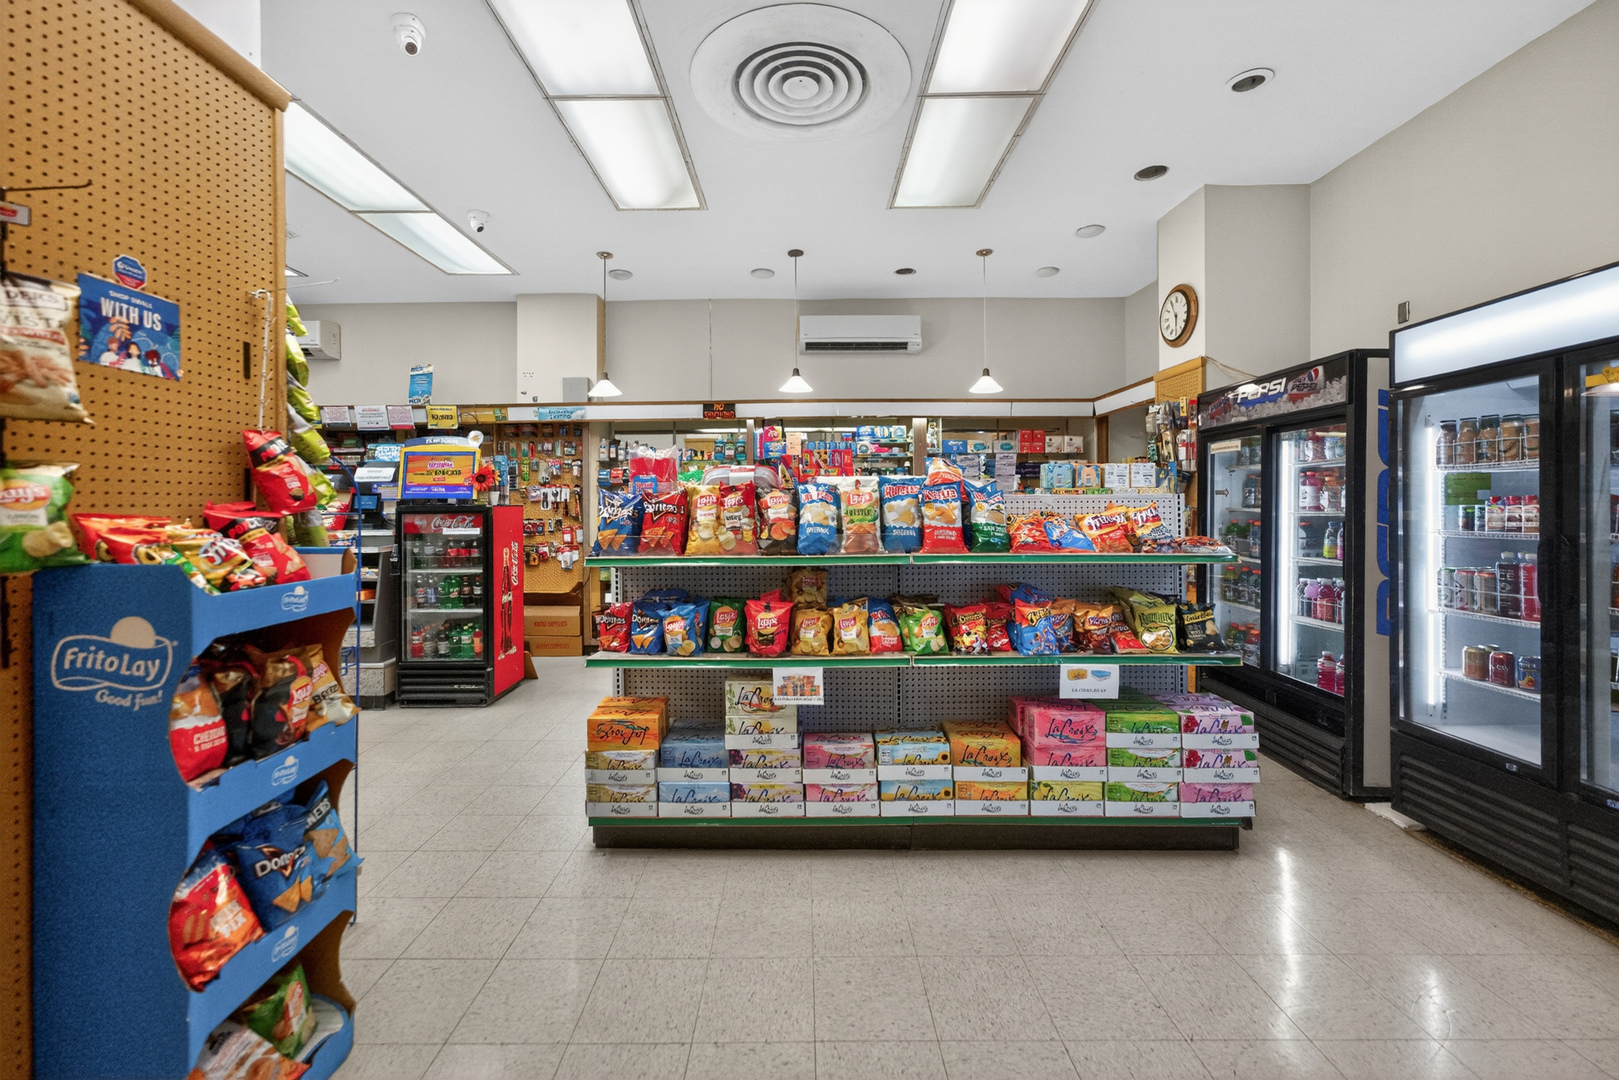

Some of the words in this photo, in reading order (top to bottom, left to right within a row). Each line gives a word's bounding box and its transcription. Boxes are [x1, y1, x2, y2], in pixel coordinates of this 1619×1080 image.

[101, 297, 139, 326] WITH
[142, 310, 162, 332] US
[1236, 377, 1287, 404] PEPSI
[95, 688, 132, 707] Good
[133, 690, 163, 711] fun!
[1045, 718, 1098, 740] LaCroix
